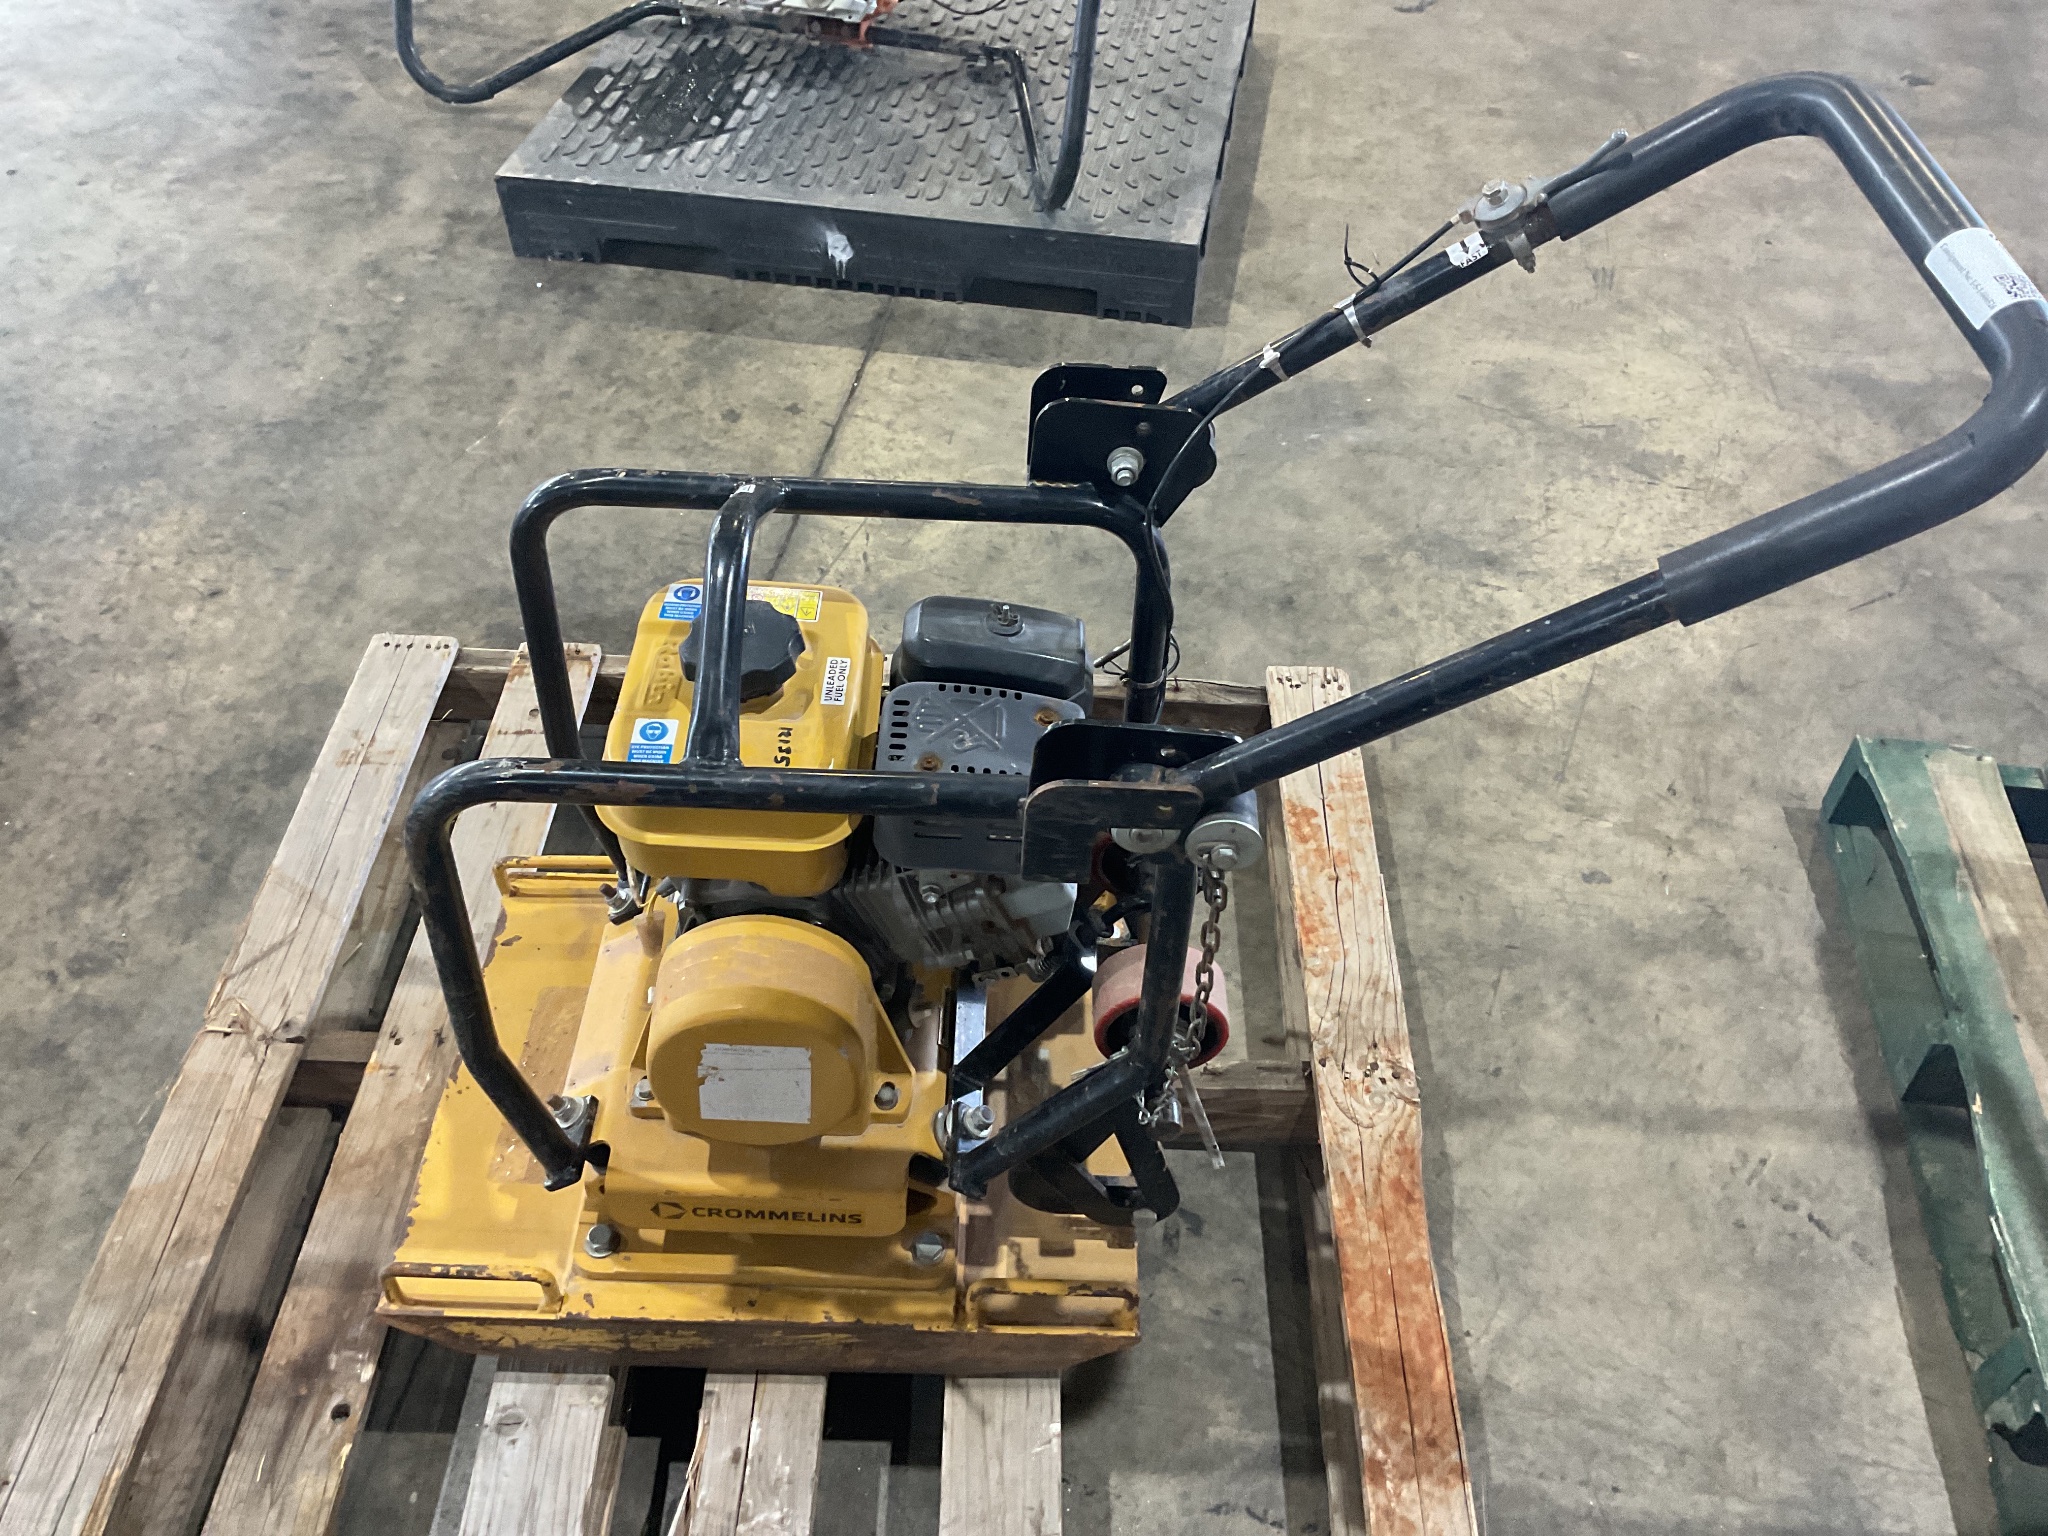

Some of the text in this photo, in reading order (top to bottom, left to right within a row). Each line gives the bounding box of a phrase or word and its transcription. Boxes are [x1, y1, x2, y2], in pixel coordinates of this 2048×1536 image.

[824, 659, 839, 702] UNLEADED
[833, 659, 848, 702] FUEL ONLY
[691, 1207, 863, 1224] CROMMELINS
